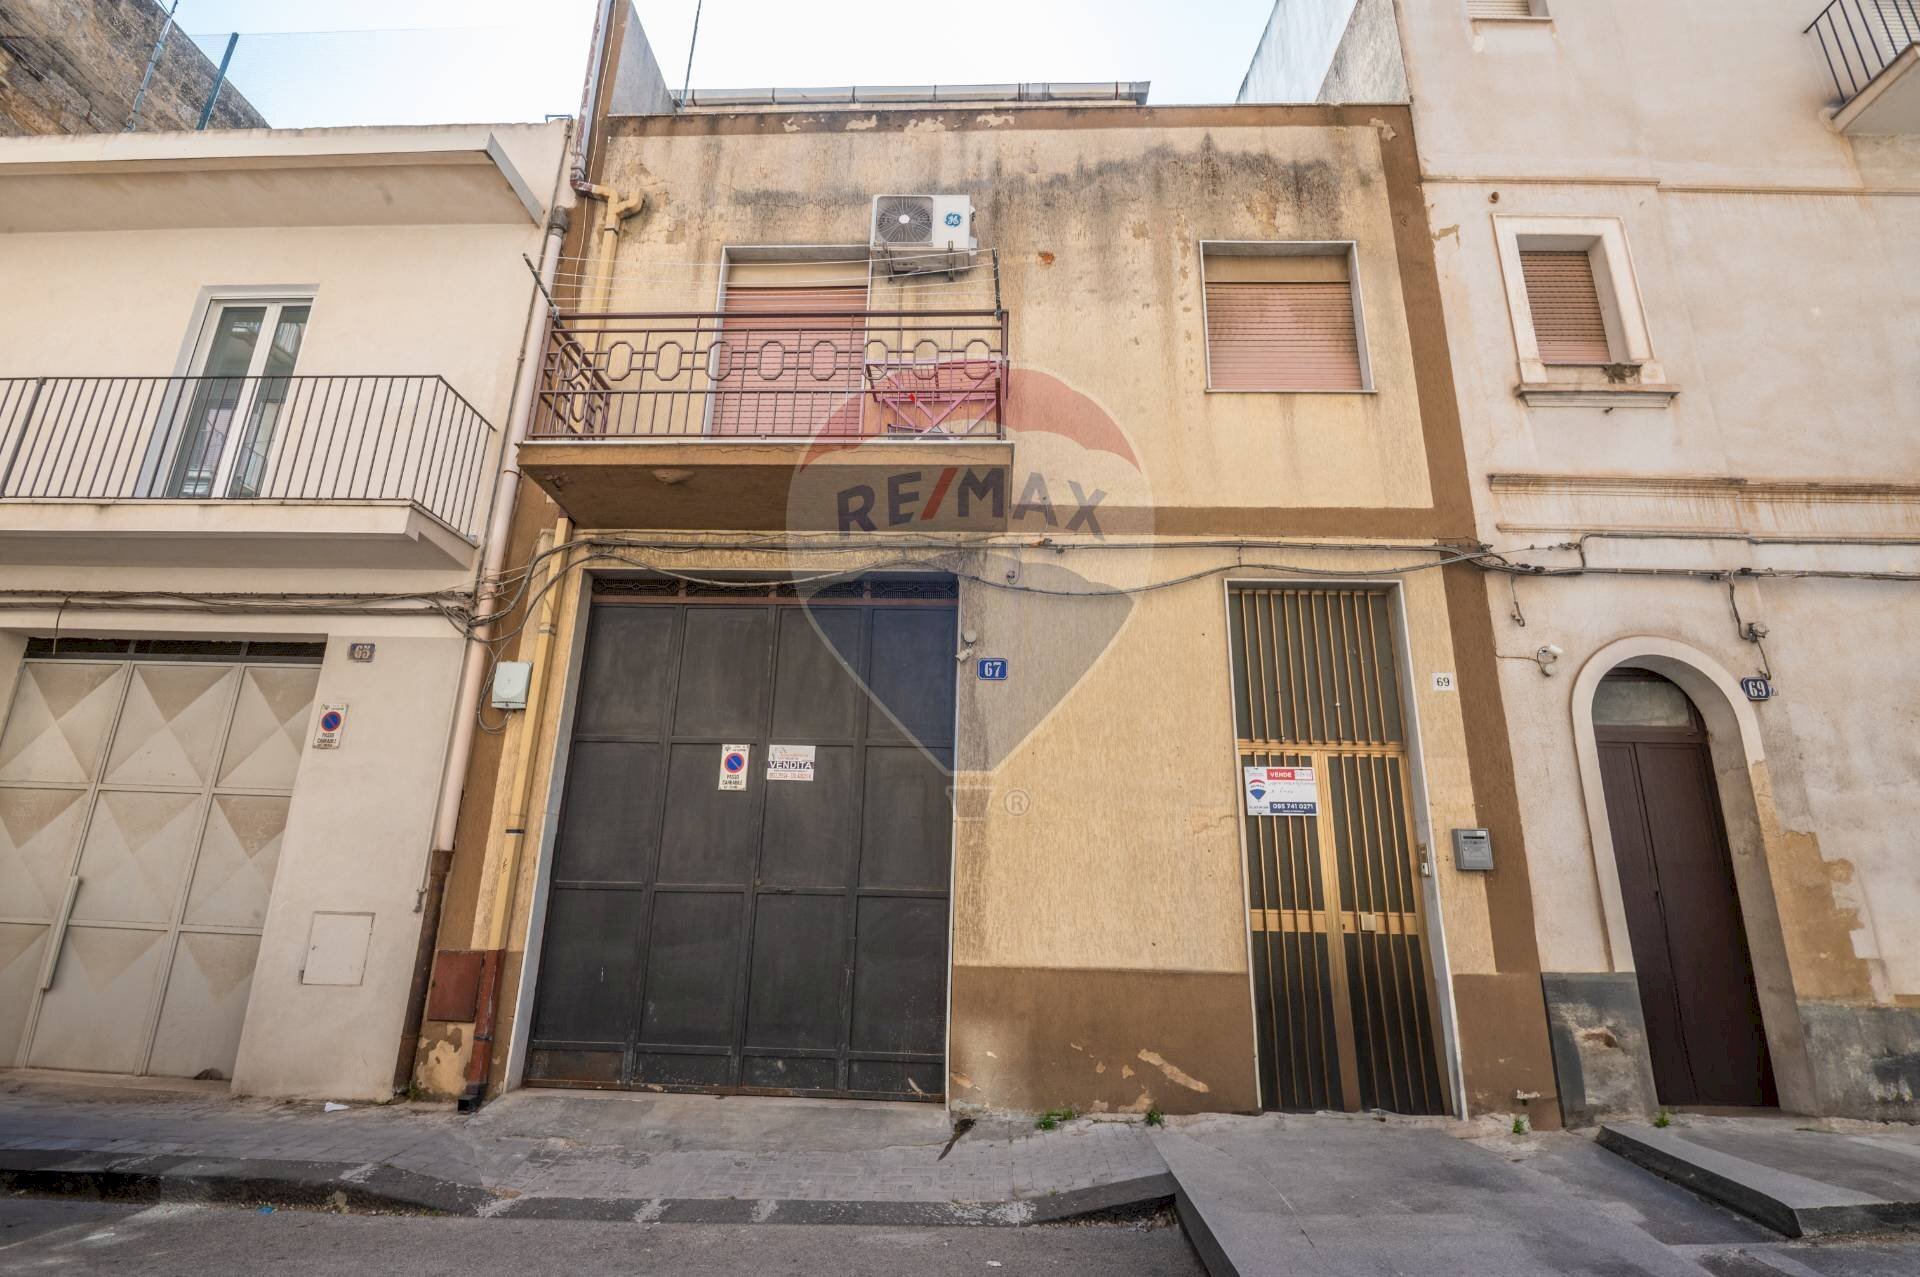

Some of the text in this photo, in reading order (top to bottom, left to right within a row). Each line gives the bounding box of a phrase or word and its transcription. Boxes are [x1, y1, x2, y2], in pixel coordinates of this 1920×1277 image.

[984, 661, 1002, 678] 67
[1436, 676, 1450, 687] 69
[1748, 680, 1767, 697] 69
[769, 761, 812, 769] VENDITA
